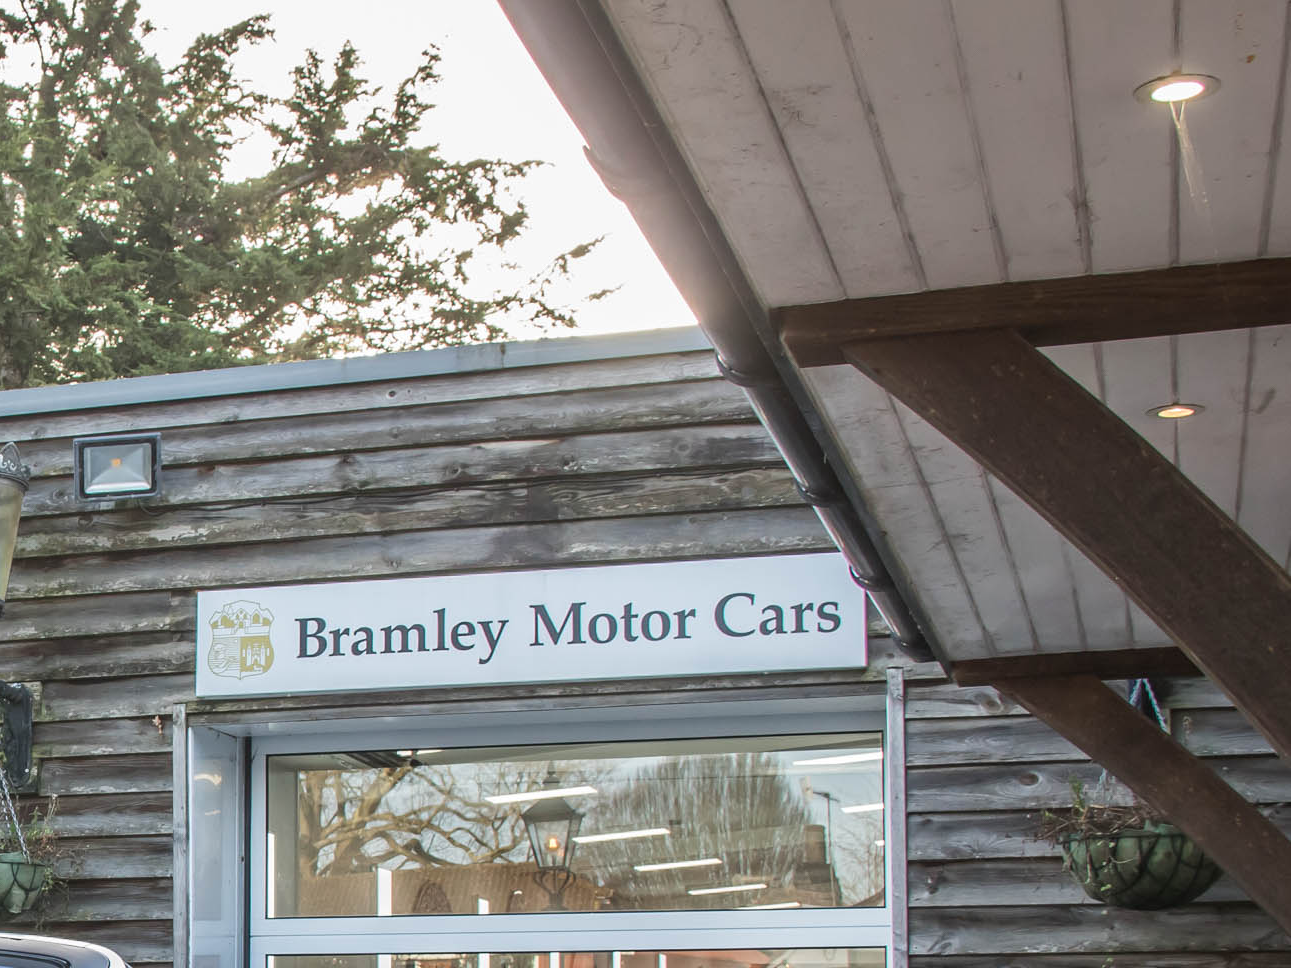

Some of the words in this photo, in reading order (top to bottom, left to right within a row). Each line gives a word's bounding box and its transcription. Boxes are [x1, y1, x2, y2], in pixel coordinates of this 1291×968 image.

[294, 608, 509, 664] Bramley
[529, 601, 696, 647] Motor
[713, 592, 842, 637] Cars
